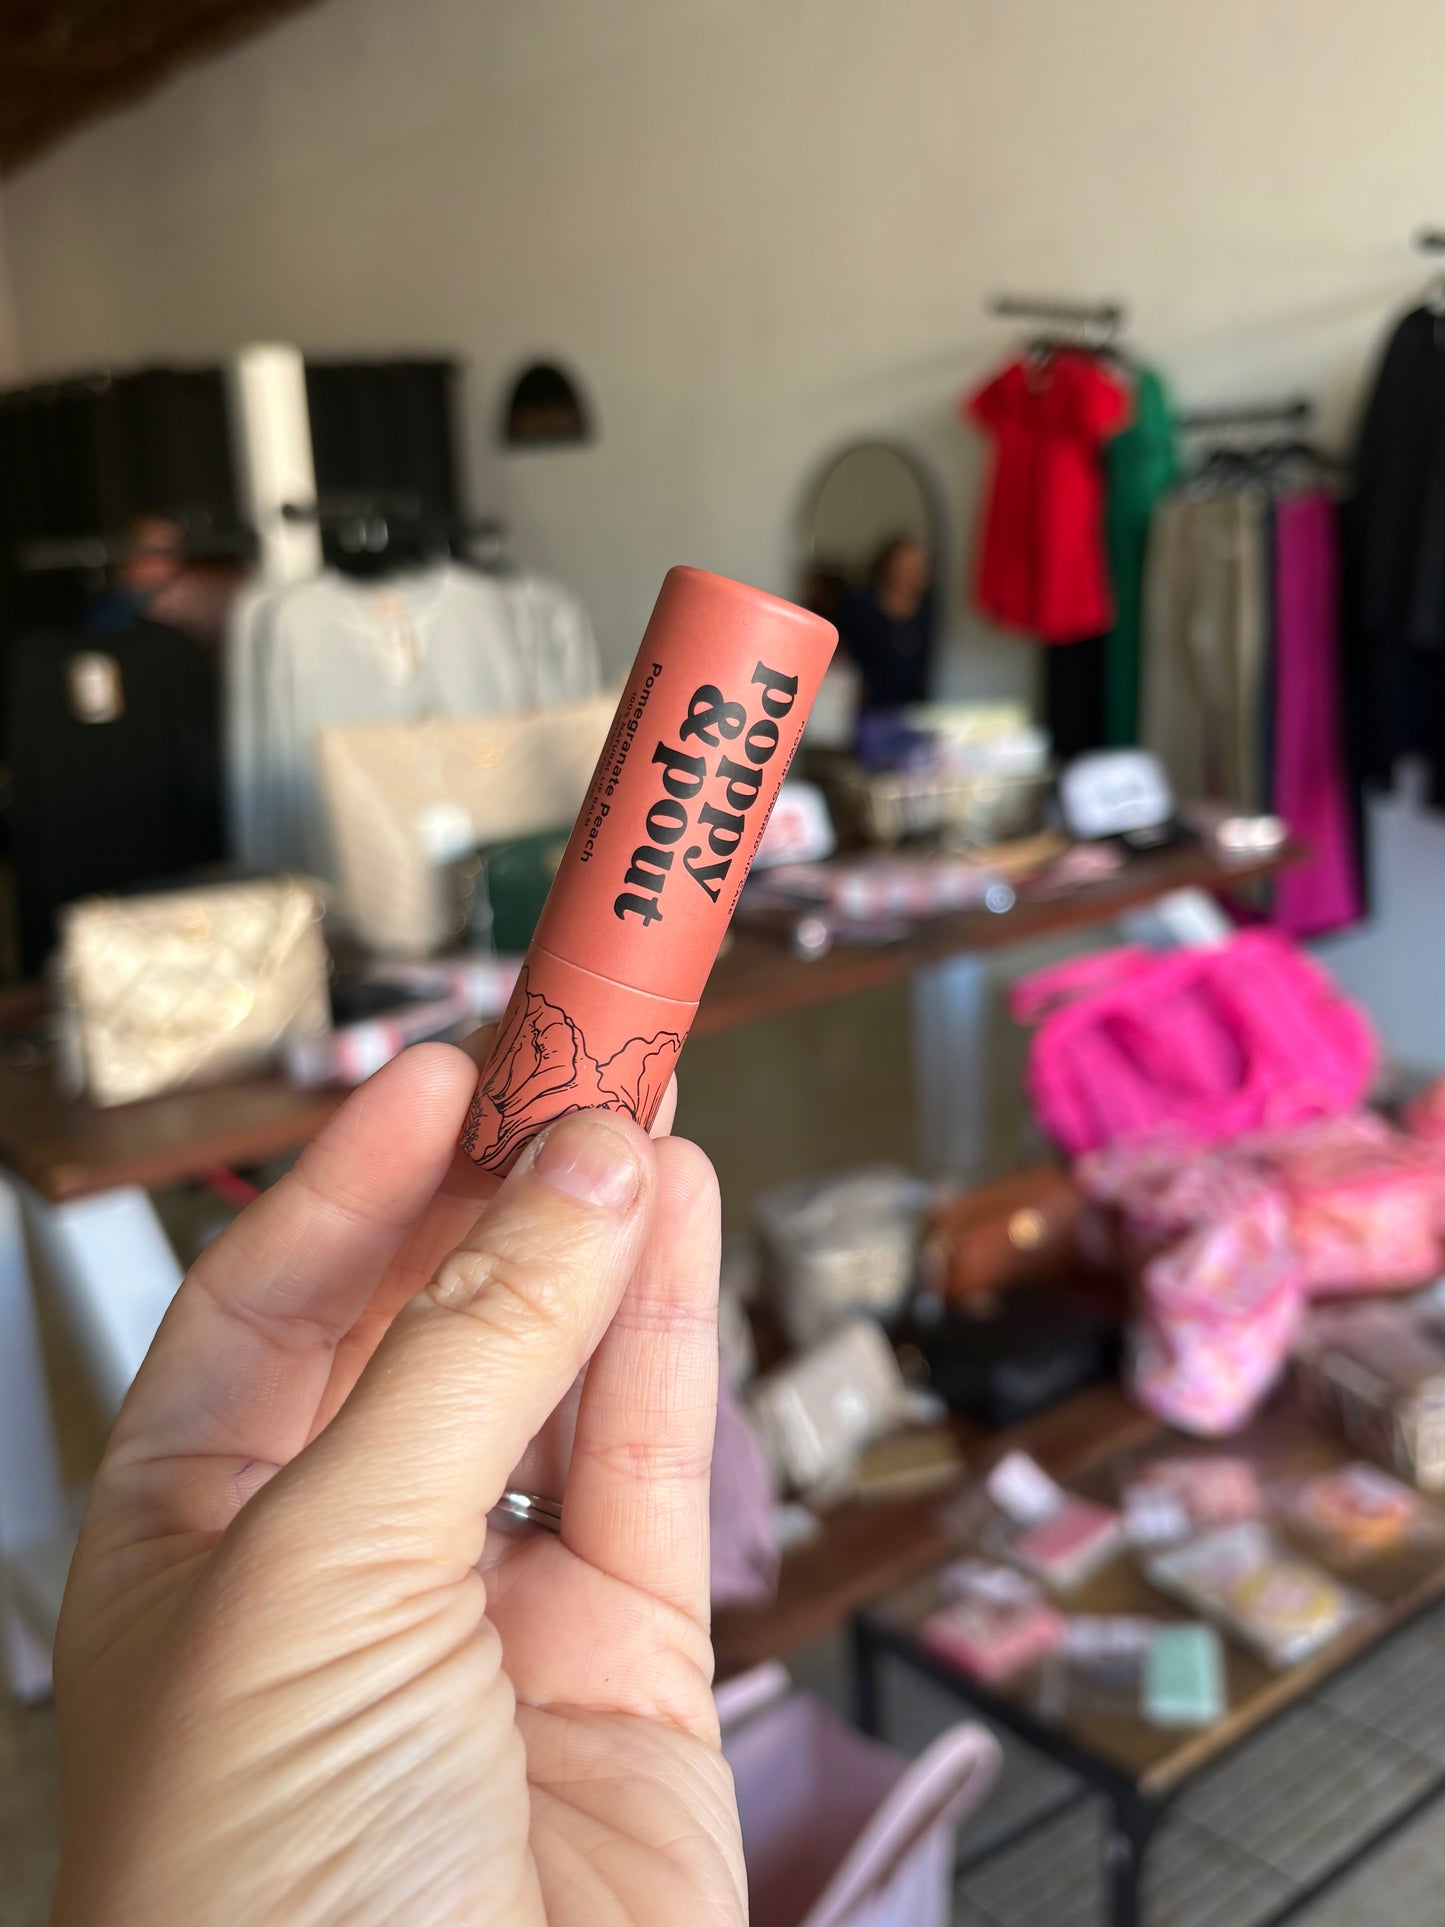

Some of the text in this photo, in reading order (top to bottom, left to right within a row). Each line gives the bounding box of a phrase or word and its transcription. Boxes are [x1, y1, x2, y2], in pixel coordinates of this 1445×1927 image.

[604, 722, 626, 771] NATURAL
[605, 662, 663, 796] Pomegranate
[583, 797, 599, 827] BALM
[614, 684, 747, 927] & pout
[683, 661, 798, 903] poppy
[580, 802, 611, 862] Peach
